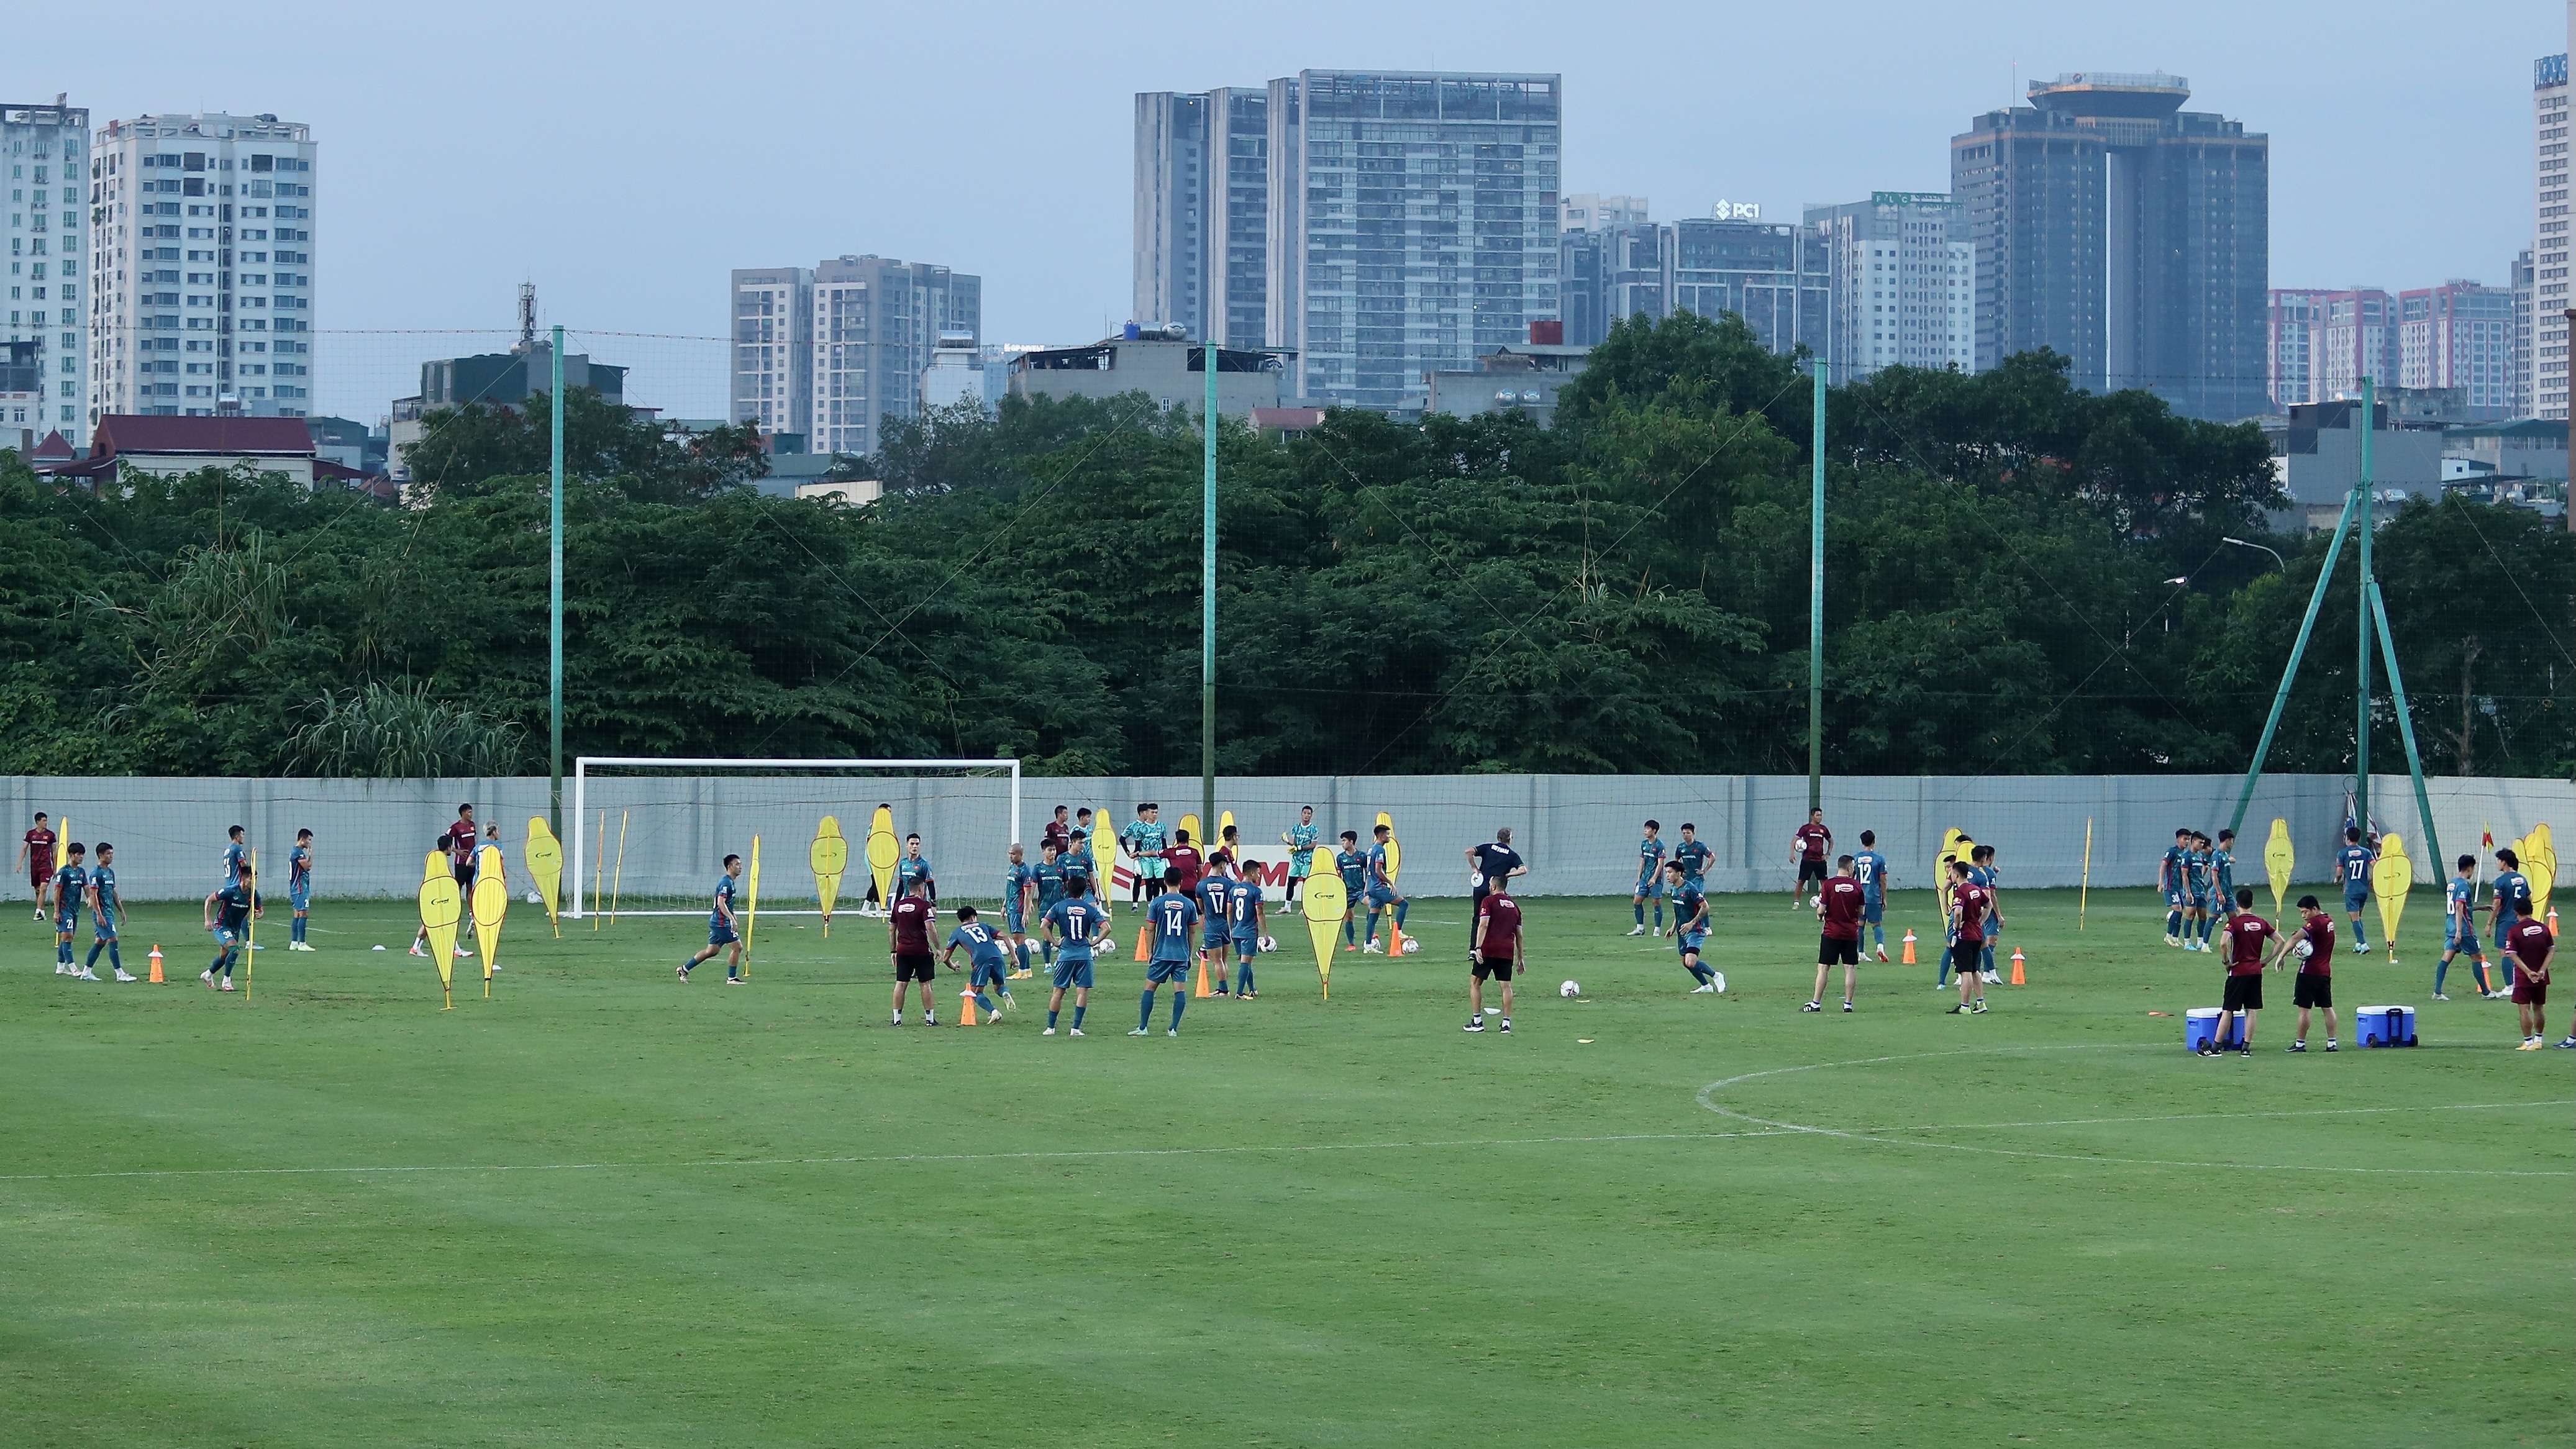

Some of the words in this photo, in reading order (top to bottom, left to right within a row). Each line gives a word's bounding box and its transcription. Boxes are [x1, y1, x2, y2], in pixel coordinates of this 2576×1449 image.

[1876, 195, 1908, 204] FLC
[1857, 863, 1872, 884] 12
[2349, 860, 2364, 880] 27
[1208, 891, 1224, 914] 17
[1236, 897, 1244, 921] 8
[1068, 915, 1083, 940] 11
[1165, 910, 1183, 936] 14
[964, 926, 988, 944] 13
